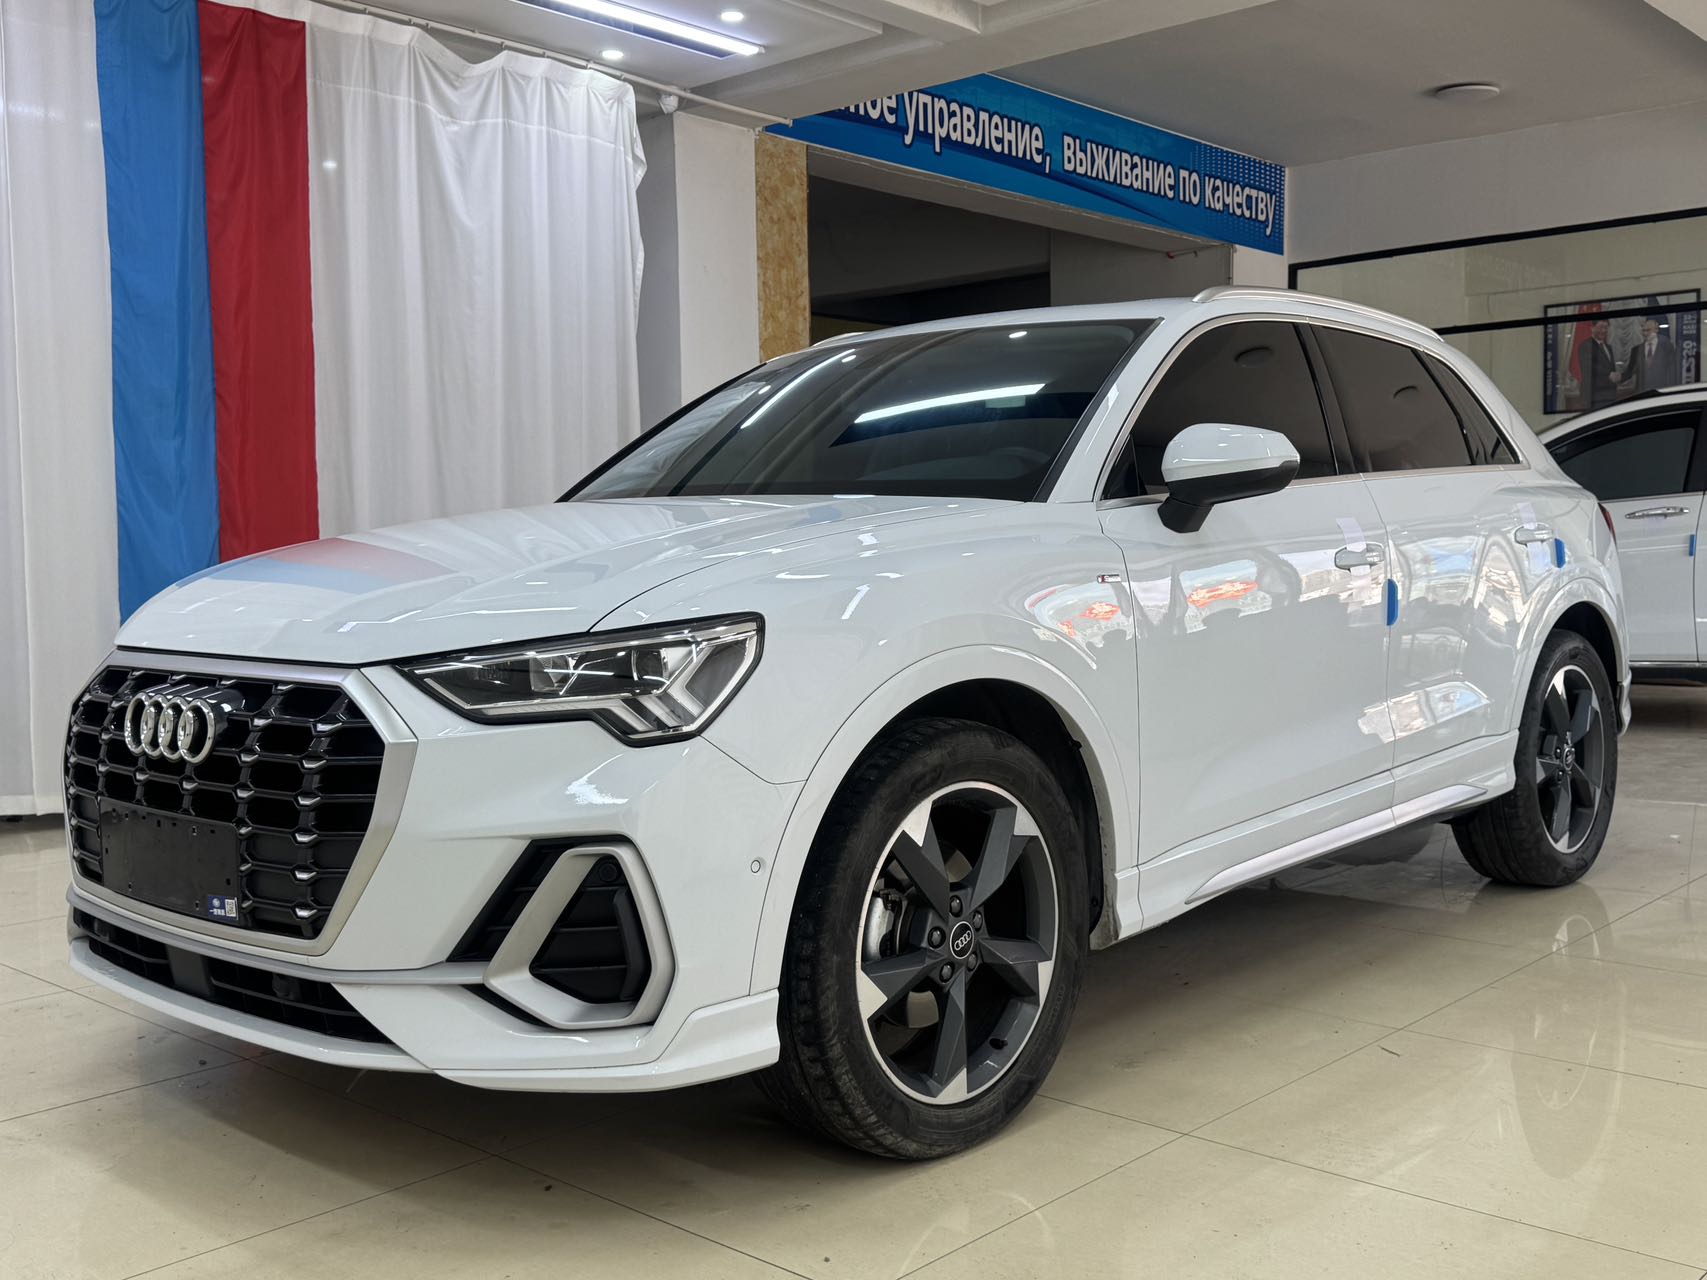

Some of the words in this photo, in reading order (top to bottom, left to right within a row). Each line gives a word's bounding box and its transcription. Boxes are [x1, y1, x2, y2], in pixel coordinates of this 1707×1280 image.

[903, 88, 1050, 174] управление,
[1063, 135, 1175, 198] выживание
[1179, 168, 1201, 206] по
[1205, 176, 1276, 236] качеству
